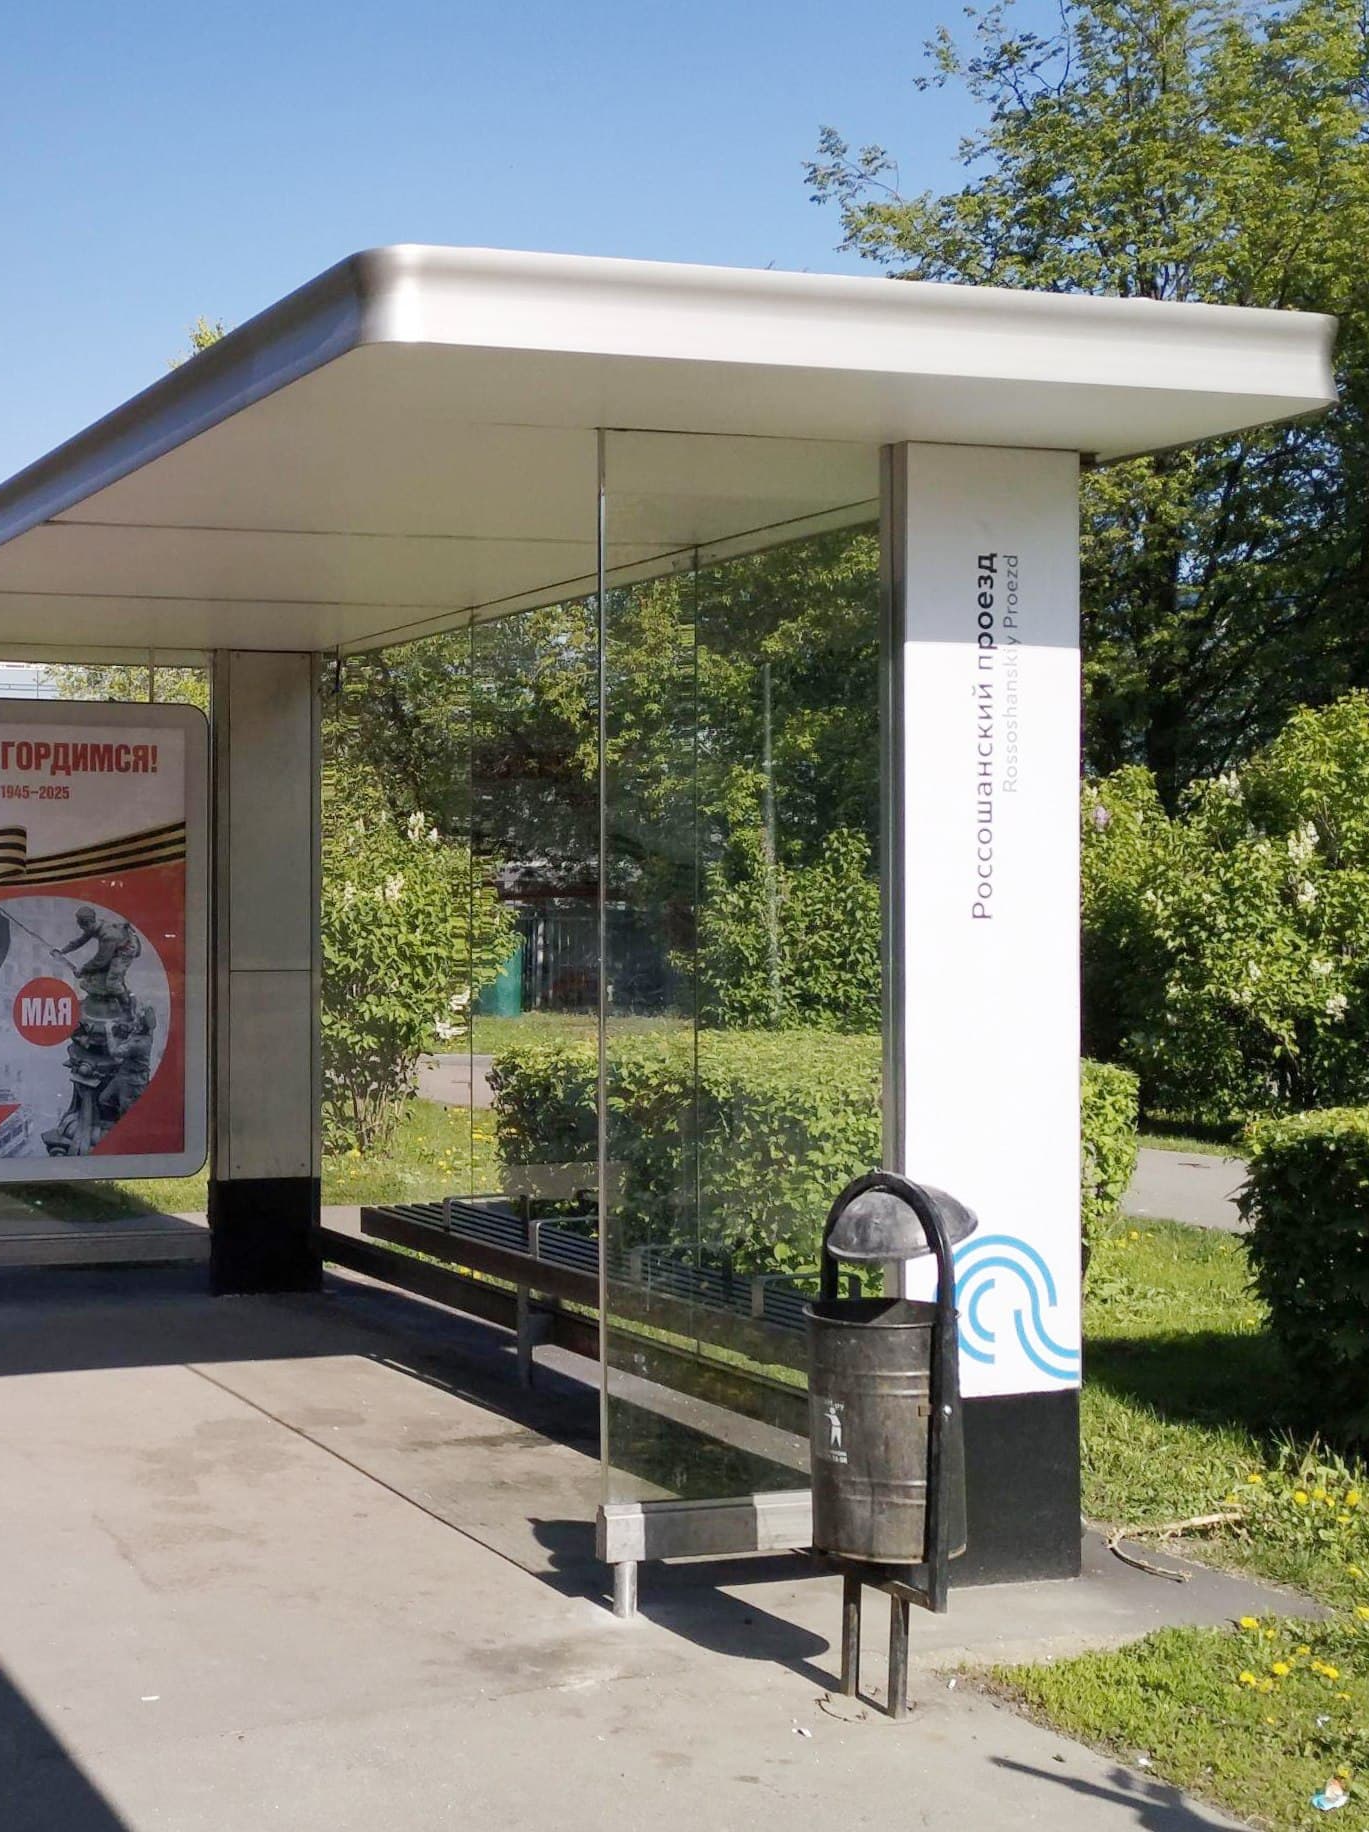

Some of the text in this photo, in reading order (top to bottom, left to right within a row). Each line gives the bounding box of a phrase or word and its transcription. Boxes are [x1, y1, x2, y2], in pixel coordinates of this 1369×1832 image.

[972, 552, 997, 919] Россошанский проезд
[1002, 554, 1021, 793] Rossoshanskiy Proezd
[1, 741, 158, 776] ГОРДИМСЯ!
[21, 996, 72, 1026] МАЯ
